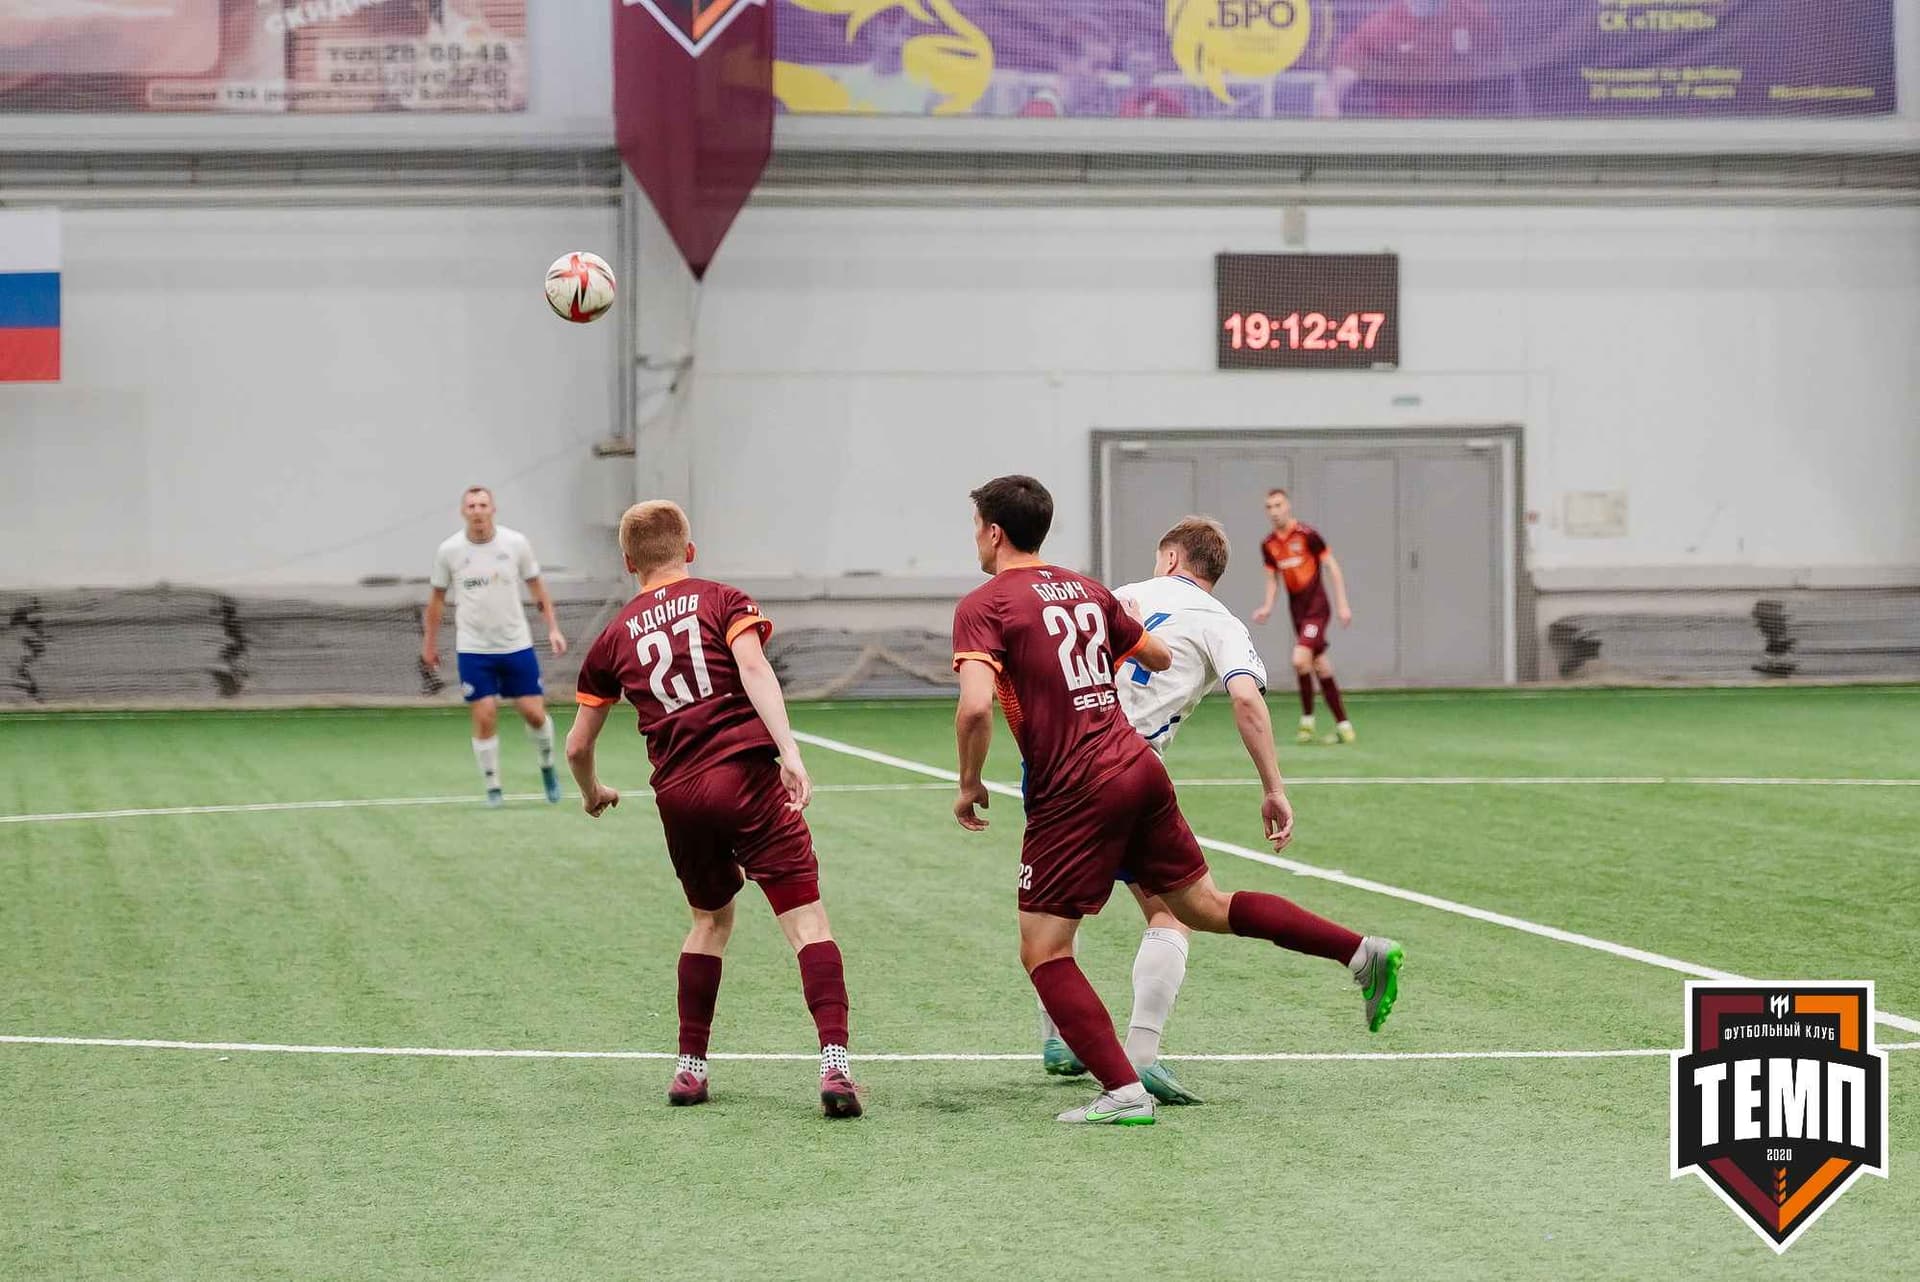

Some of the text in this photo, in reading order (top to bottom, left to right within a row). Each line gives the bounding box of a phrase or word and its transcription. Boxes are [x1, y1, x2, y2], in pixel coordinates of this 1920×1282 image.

[1224, 312, 1385, 349] 19:12:47
[1032, 581, 1089, 602] БАБИЧ
[626, 594, 699, 639] ЖДАНОВ
[636, 614, 713, 714] 27
[1042, 603, 1113, 691] 22
